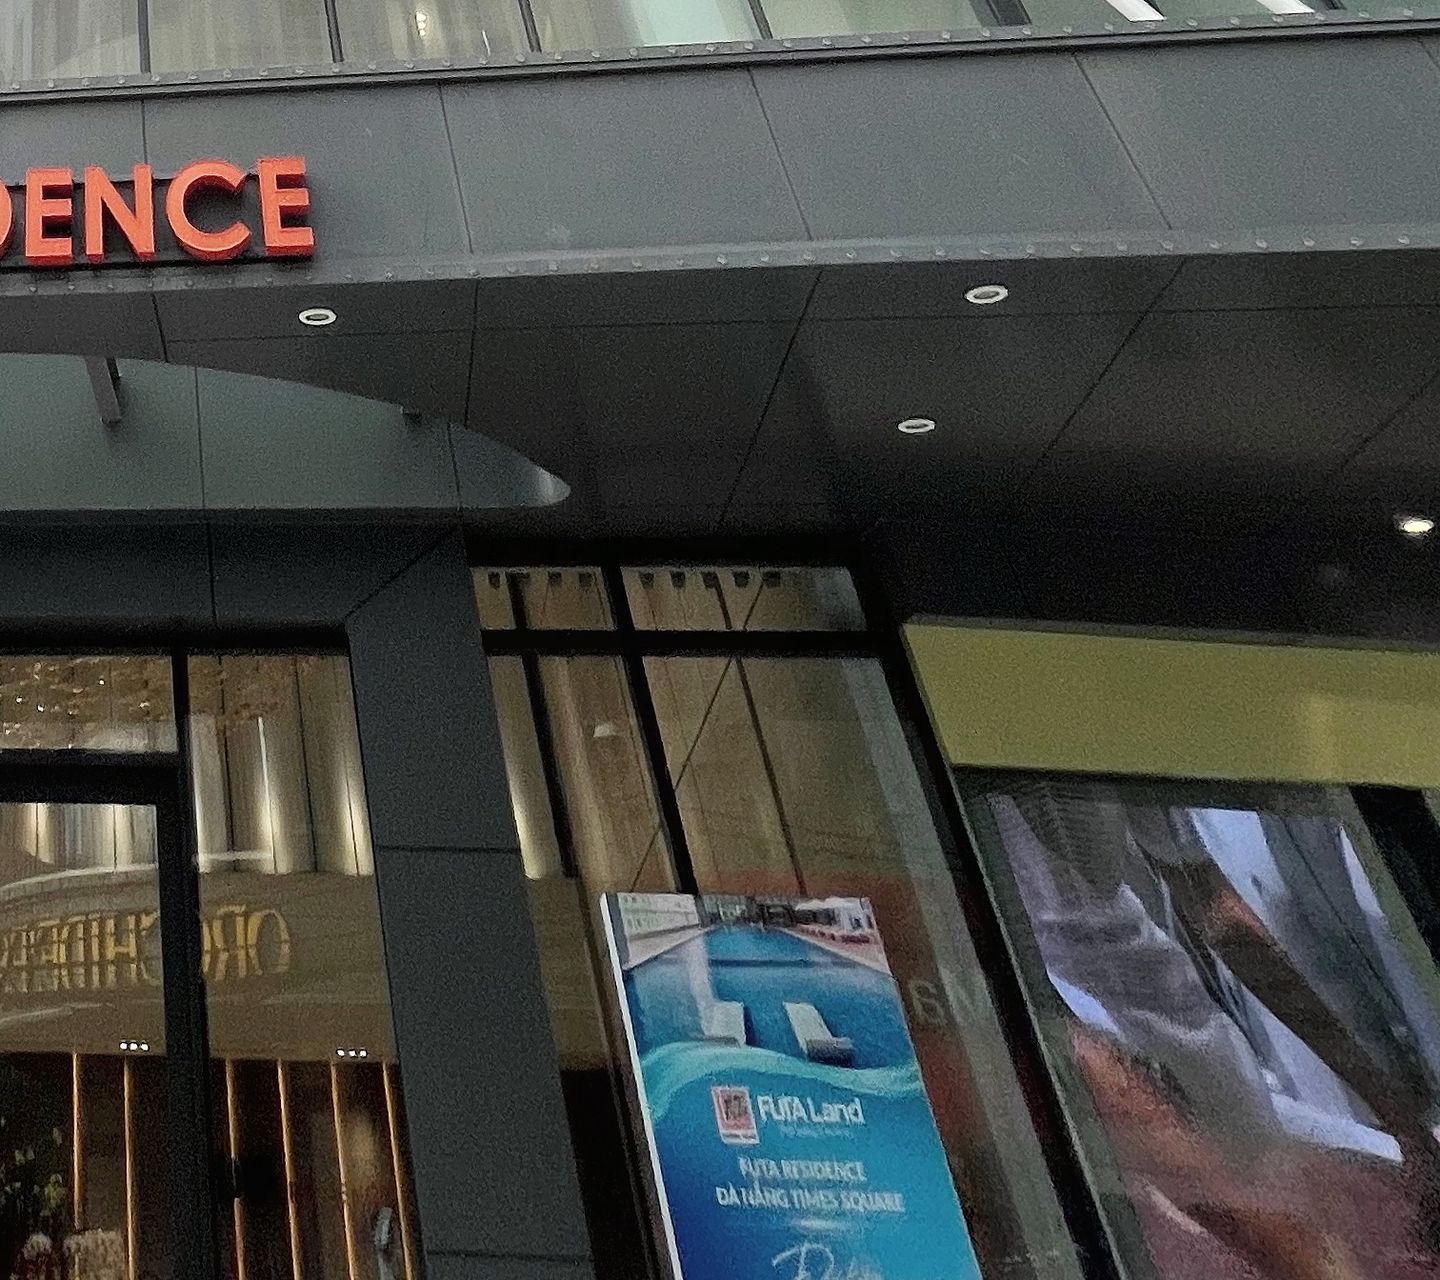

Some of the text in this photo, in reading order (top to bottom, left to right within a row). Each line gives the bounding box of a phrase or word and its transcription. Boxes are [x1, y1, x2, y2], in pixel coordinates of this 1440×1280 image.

[757, 1094, 866, 1126] FUTA Land
[781, 1159, 868, 1182] RESIDENCE
[840, 1191, 906, 1214] SQUARE
